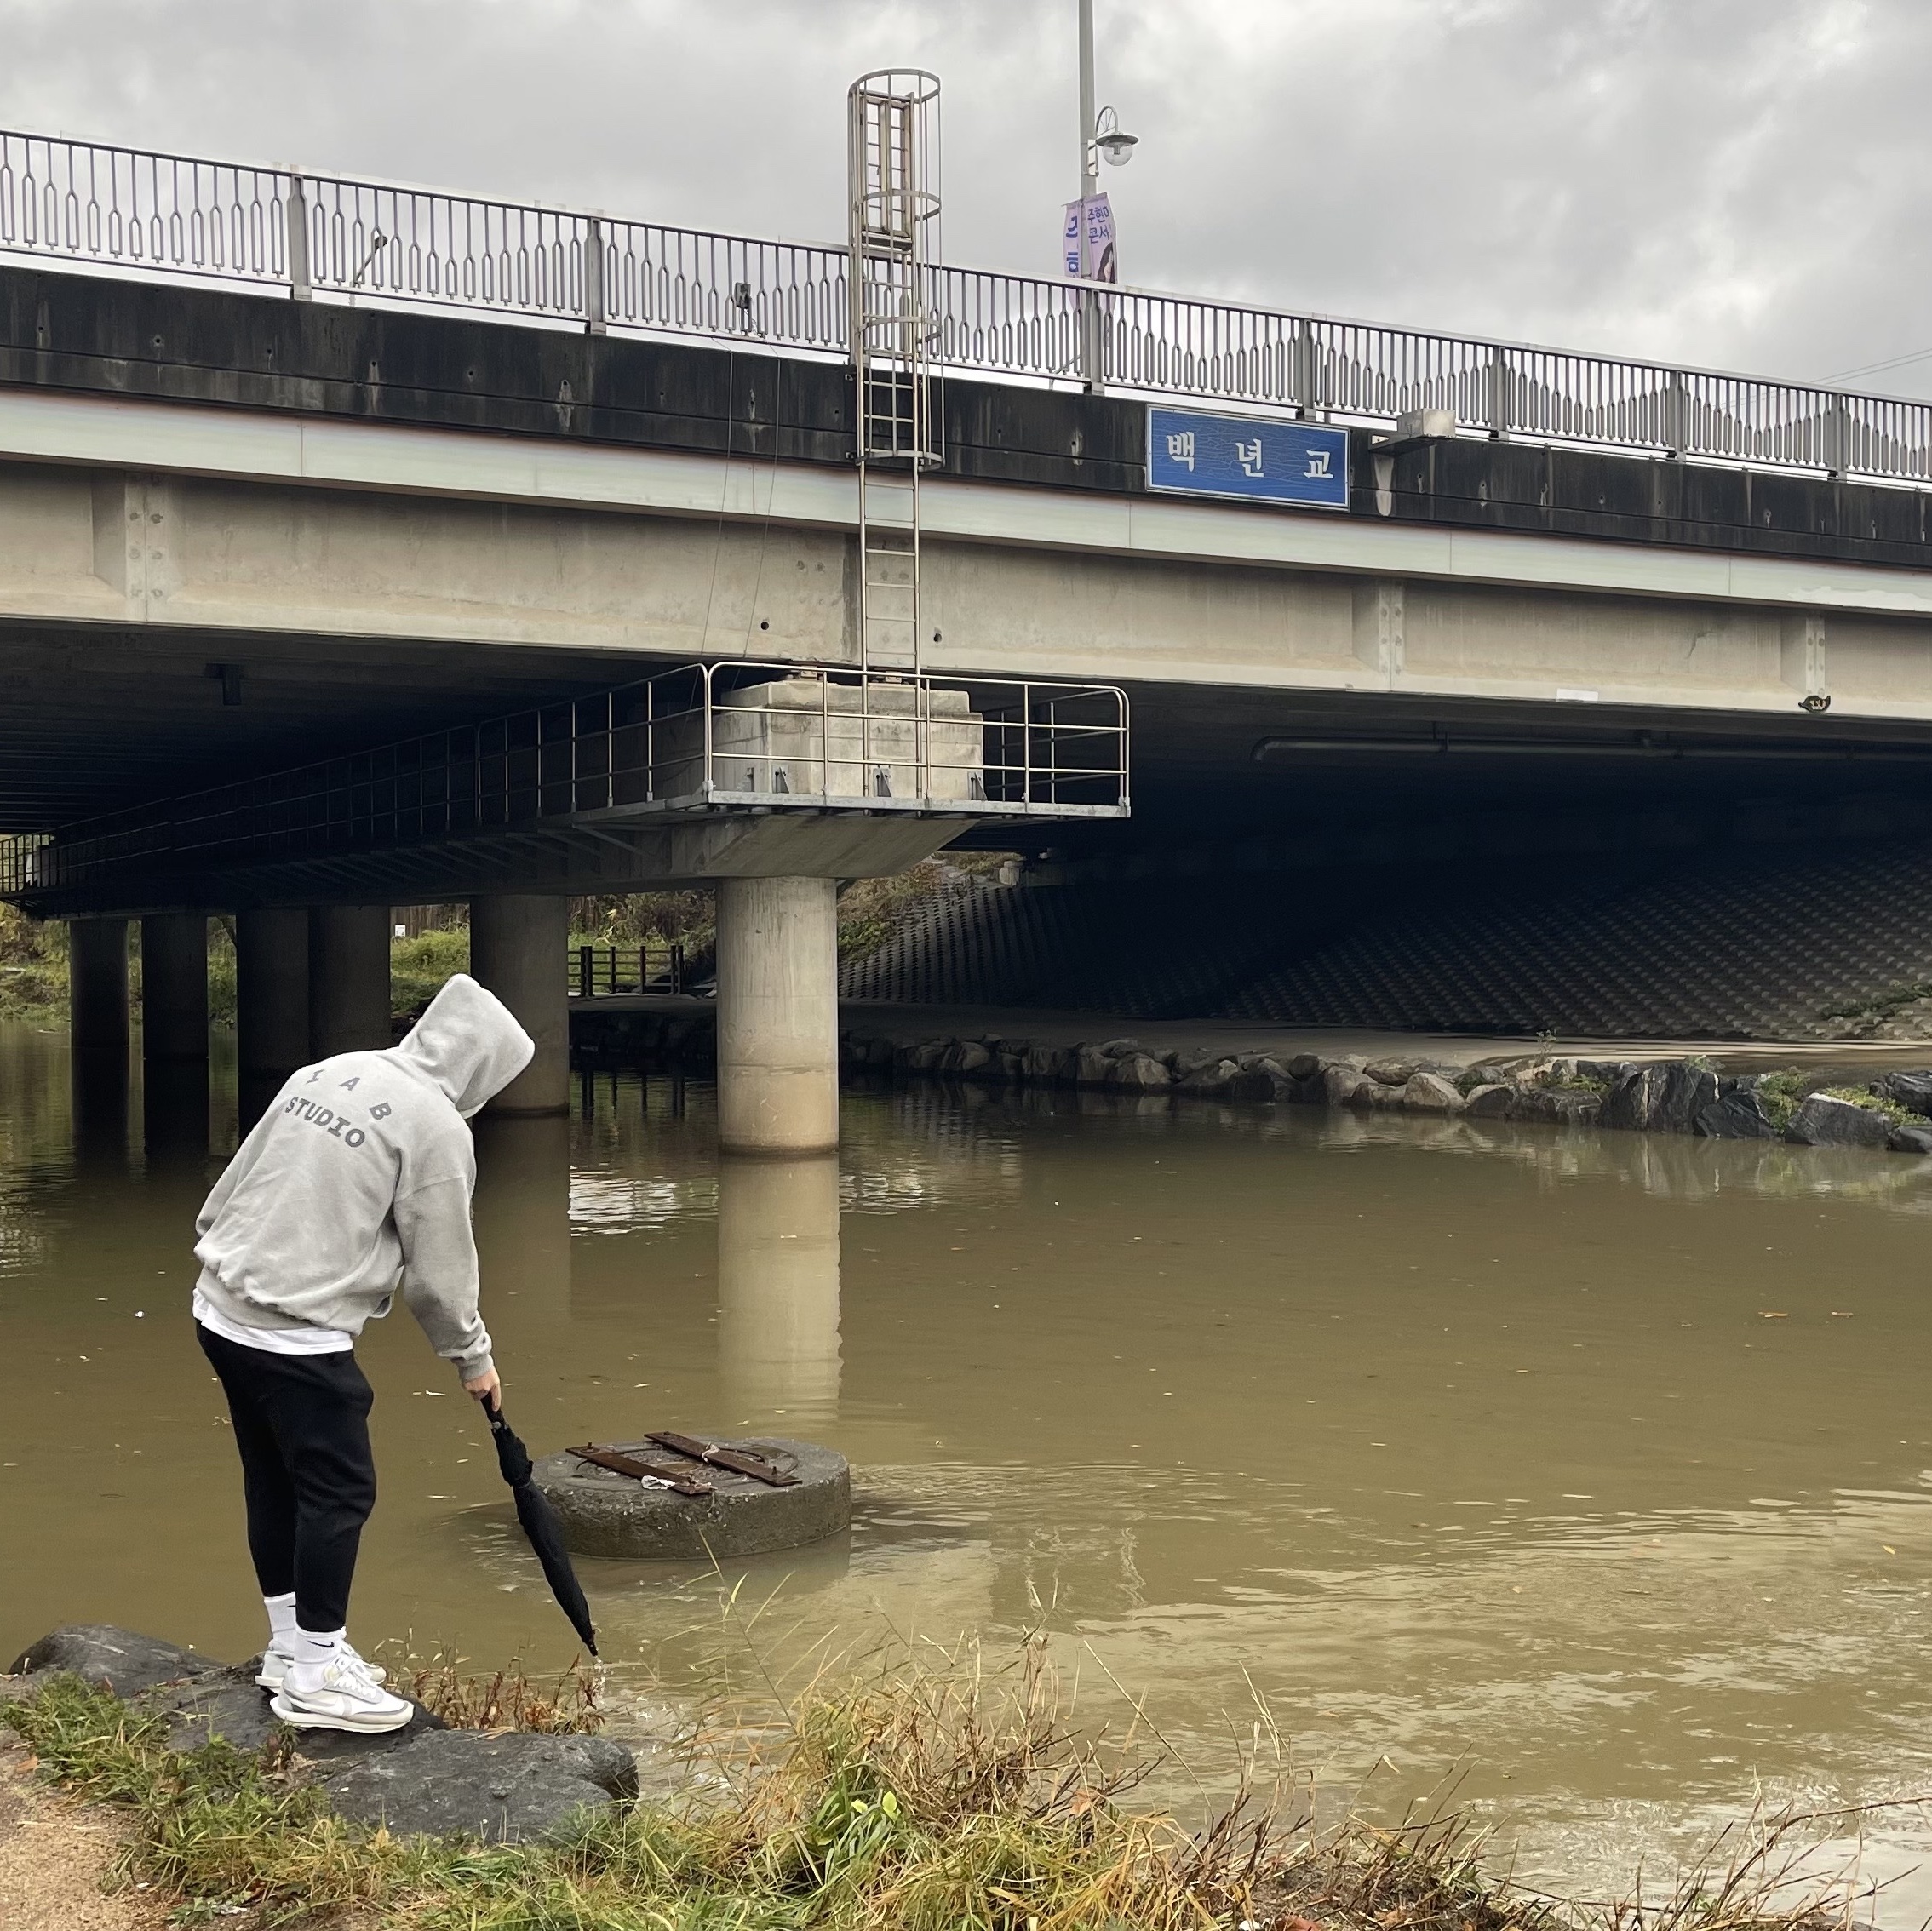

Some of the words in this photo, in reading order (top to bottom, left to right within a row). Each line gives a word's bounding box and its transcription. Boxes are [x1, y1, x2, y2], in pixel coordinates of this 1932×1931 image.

[1088, 225, 1112, 244] 콘서
[1166, 431, 1334, 478] 백년교
[284, 1096, 366, 1148] STUDIO
